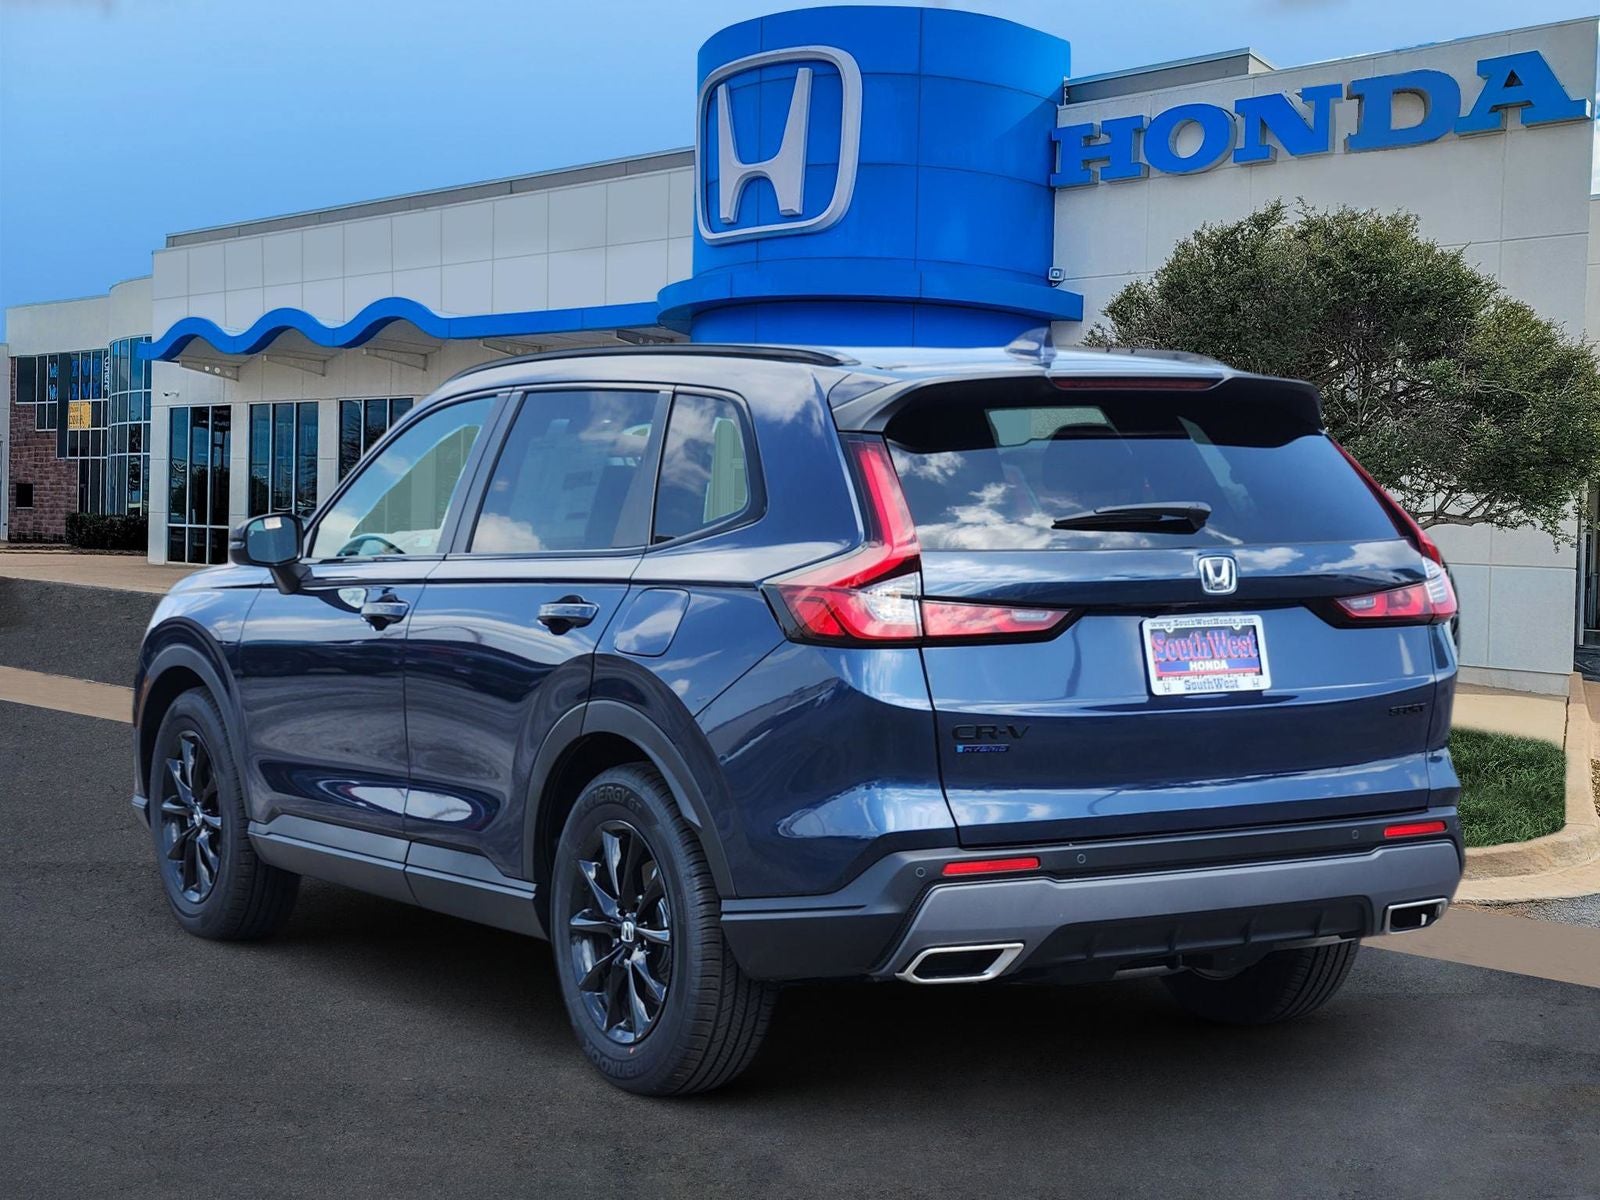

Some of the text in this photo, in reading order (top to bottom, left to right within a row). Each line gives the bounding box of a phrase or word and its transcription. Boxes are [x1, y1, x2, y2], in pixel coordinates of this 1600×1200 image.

[1051, 50, 1591, 188] HONDA
[1151, 630, 1258, 661] SouthWest
[1189, 659, 1229, 672] HONDA
[1184, 676, 1239, 692] SouthWest
[952, 723, 1031, 740] CR-V
